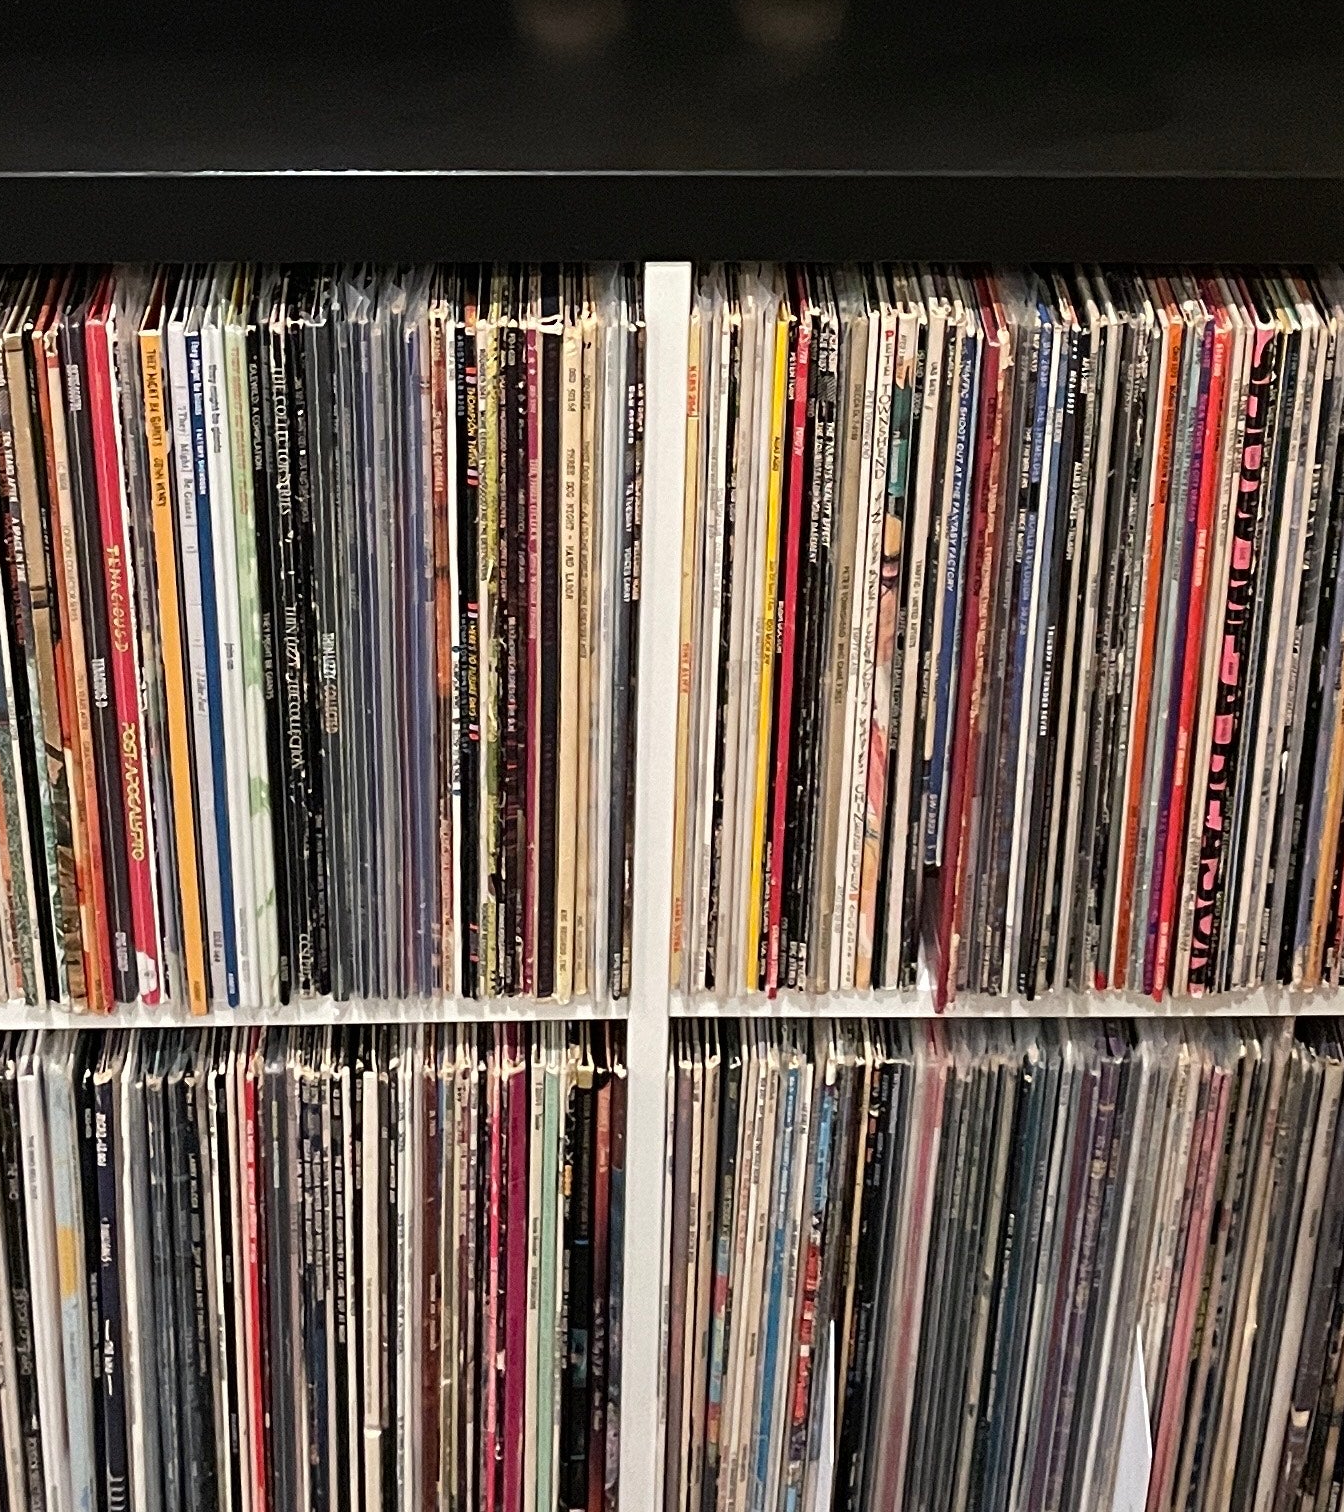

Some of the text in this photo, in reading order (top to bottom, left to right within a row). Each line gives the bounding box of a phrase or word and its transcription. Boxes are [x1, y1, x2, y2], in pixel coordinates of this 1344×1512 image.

[147, 349, 156, 370] THEY
[465, 387, 477, 437] THOMPSON
[150, 416, 162, 446] GIANTS
[565, 448, 576, 475] THREE
[91, 658, 106, 698] TENACIOUS
[105, 545, 145, 861] TENACIOUS D POST-APOCALYPTO
